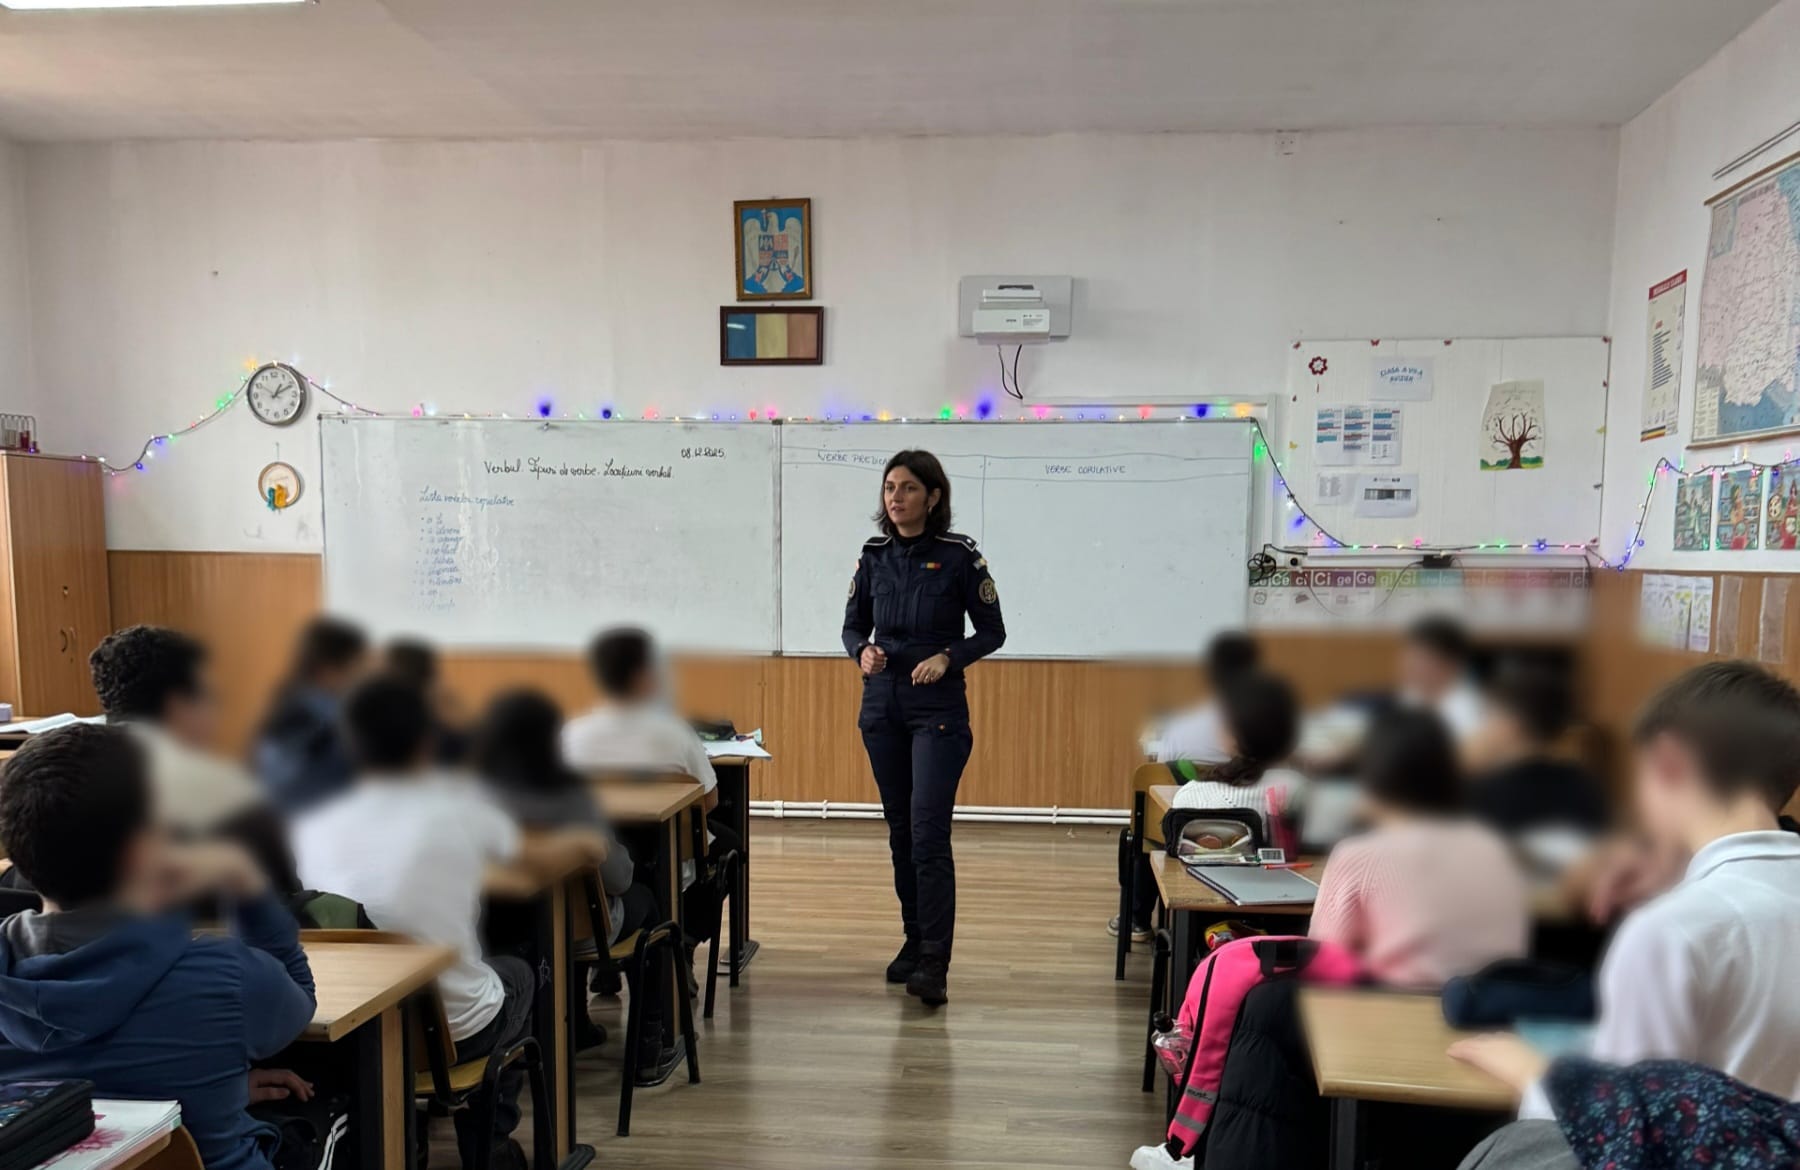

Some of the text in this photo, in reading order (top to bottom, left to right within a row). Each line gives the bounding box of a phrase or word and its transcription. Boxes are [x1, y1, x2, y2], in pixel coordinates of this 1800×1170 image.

[291, 390, 298, 398] 3
[273, 411, 280, 419] 6
[283, 408, 289, 416] 5
[1271, 573, 1290, 586] Ce
[1314, 572, 1331, 586] Ci
[1336, 575, 1352, 586] ge
[1356, 572, 1375, 584] Ge
